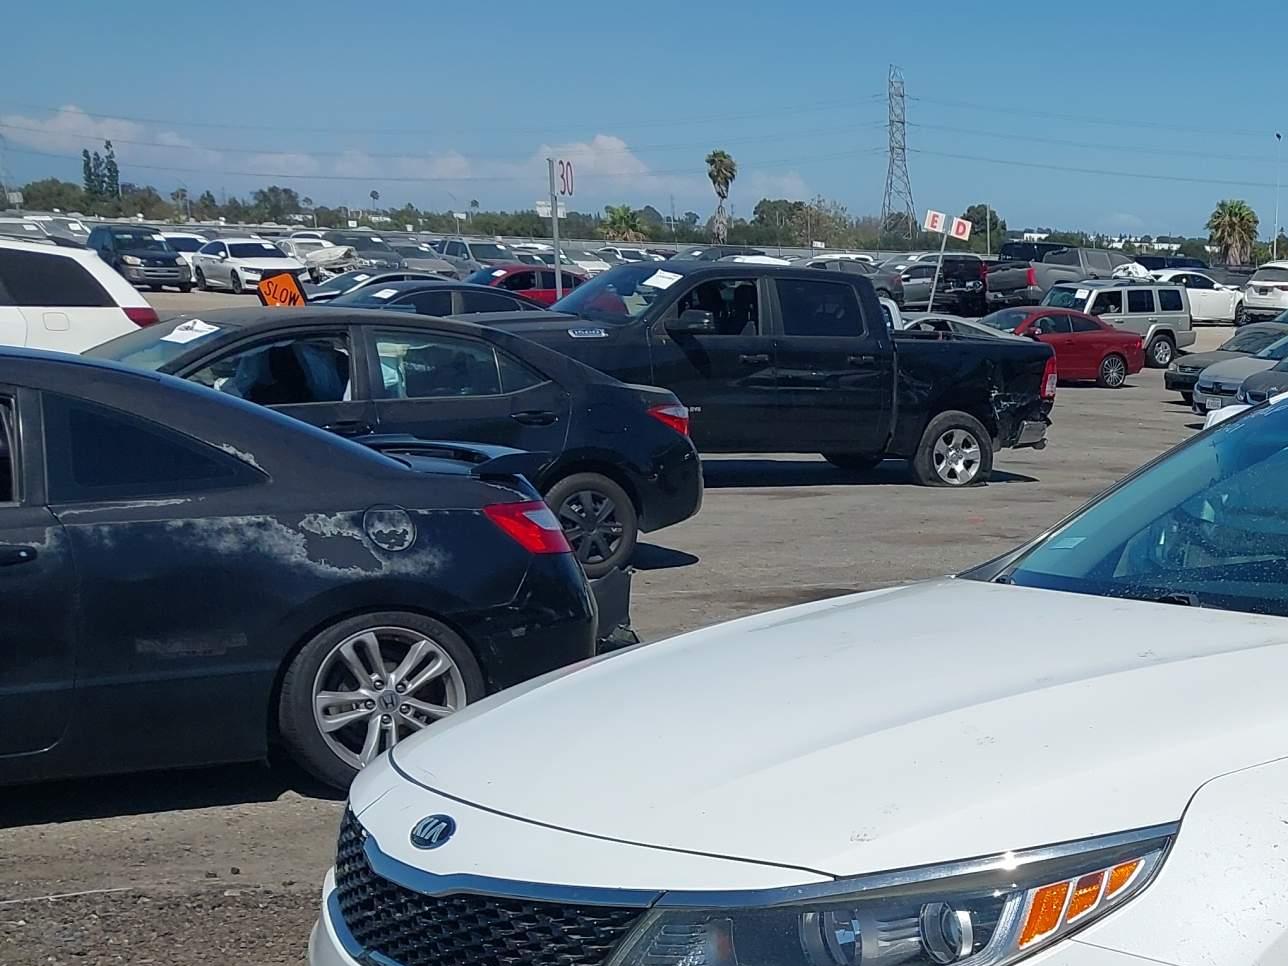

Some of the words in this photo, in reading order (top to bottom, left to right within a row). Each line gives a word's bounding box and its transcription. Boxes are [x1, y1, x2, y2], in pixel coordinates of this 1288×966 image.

[559, 160, 574, 196] 30
[930, 213, 939, 229] E
[955, 220, 967, 236] D
[264, 280, 300, 306] SLOW
[412, 817, 448, 843] KIA
